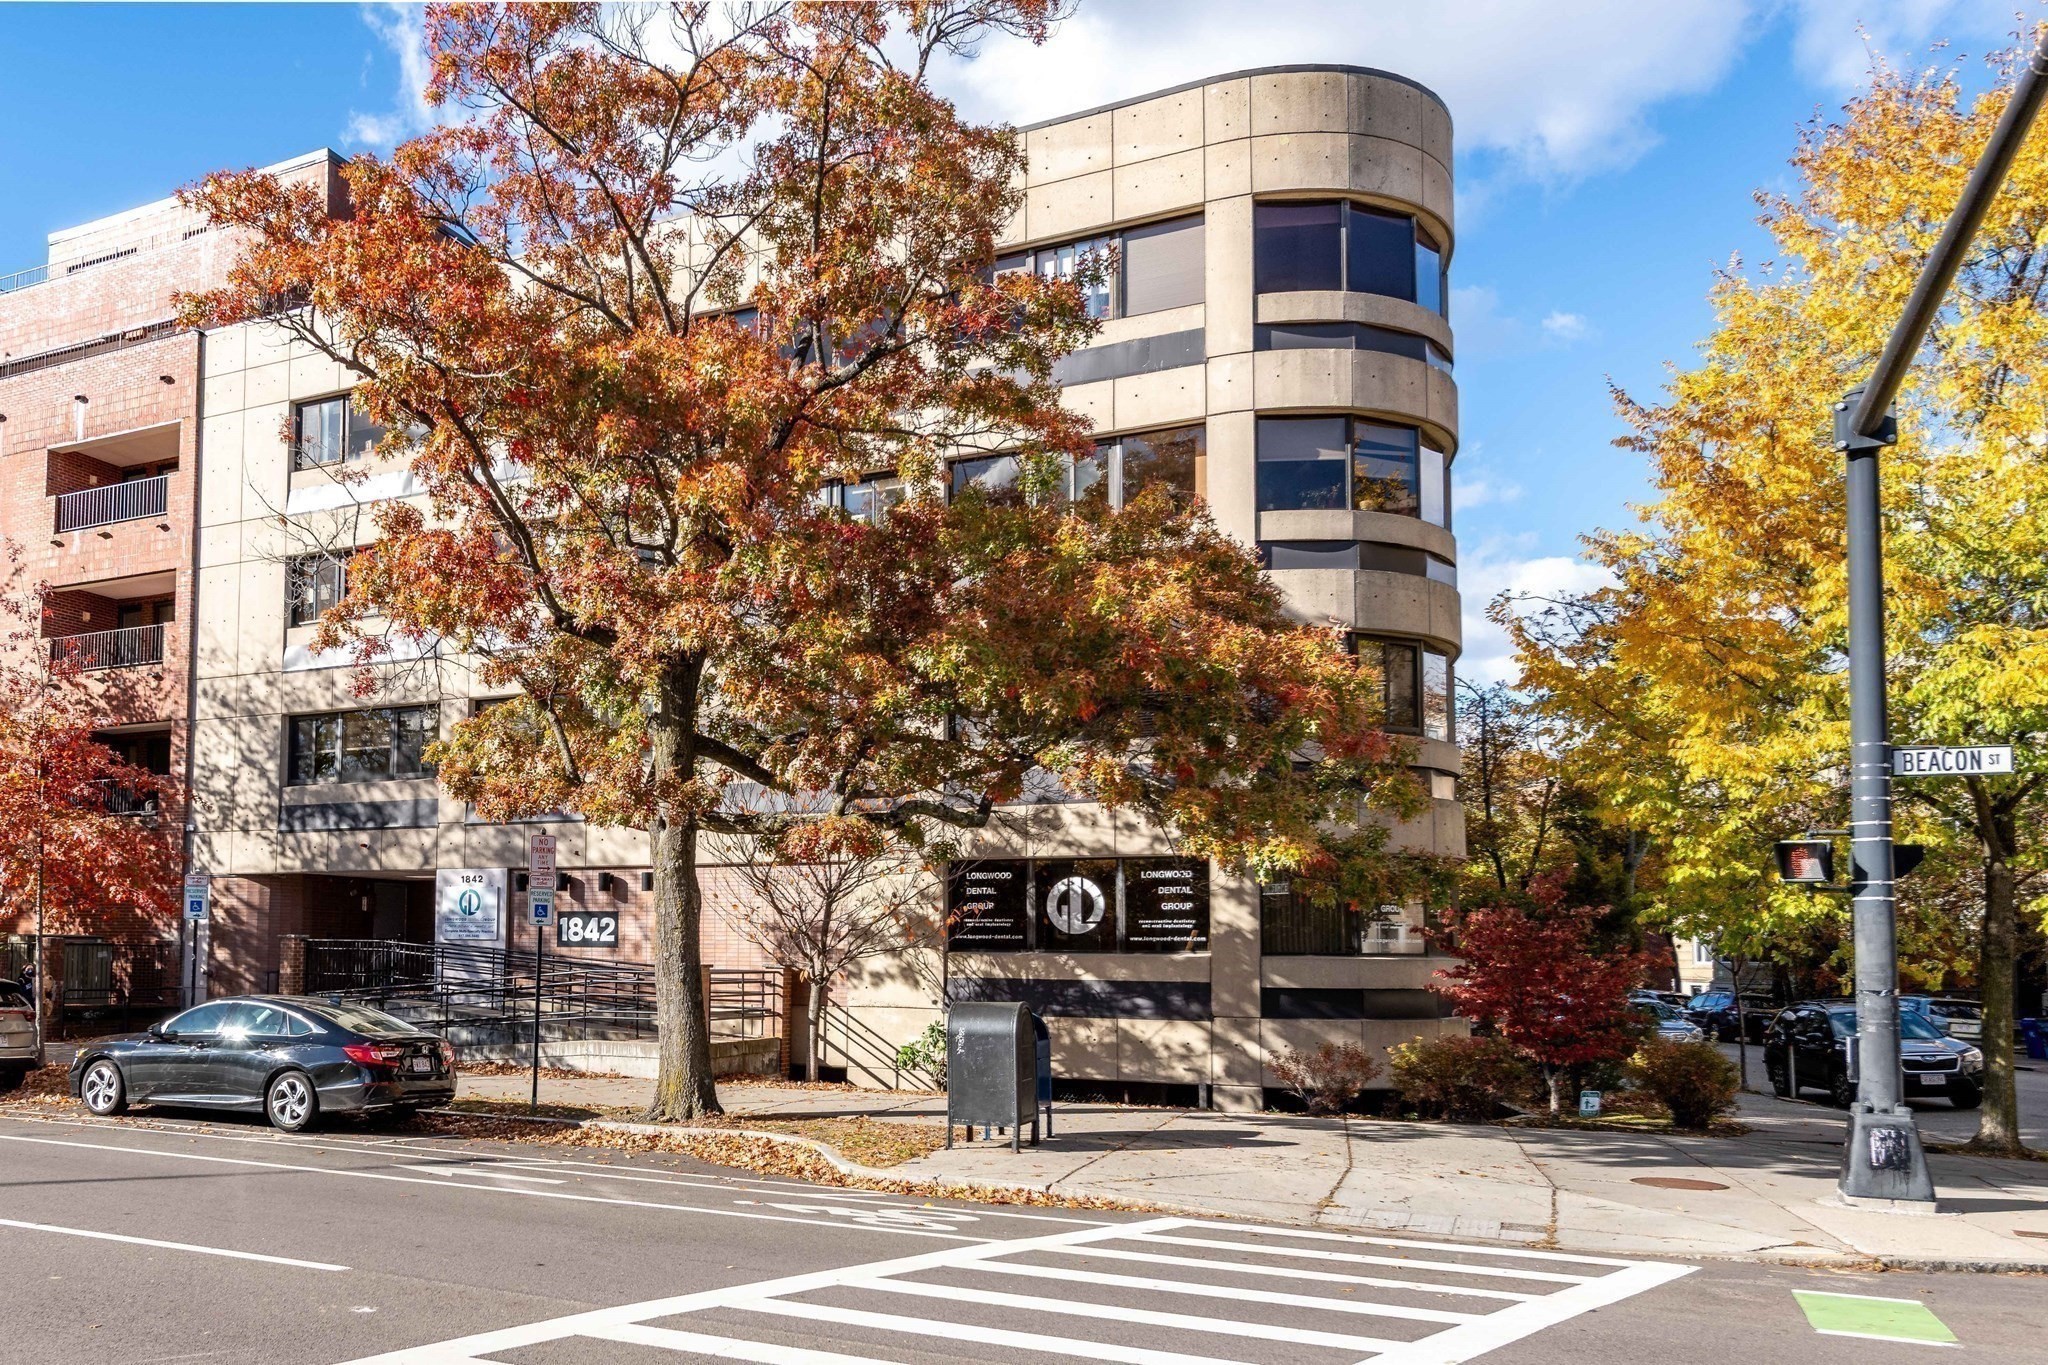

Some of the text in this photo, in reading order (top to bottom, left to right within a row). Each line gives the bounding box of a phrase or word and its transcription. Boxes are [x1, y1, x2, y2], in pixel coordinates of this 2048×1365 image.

[1903, 750, 2001, 772] BEACON ST
[538, 838, 549, 846] NO
[532, 846, 555, 855] PARKING
[966, 872, 1012, 880] LONGWOOD
[1140, 870, 1193, 879] LONGWOOD
[461, 875, 484, 883] 1842
[966, 887, 997, 895] DENTAL
[1158, 886, 1193, 894] DENTAL
[966, 902, 995, 910] GROUP
[1161, 902, 1194, 910] GROUP
[560, 917, 616, 942] 1842
